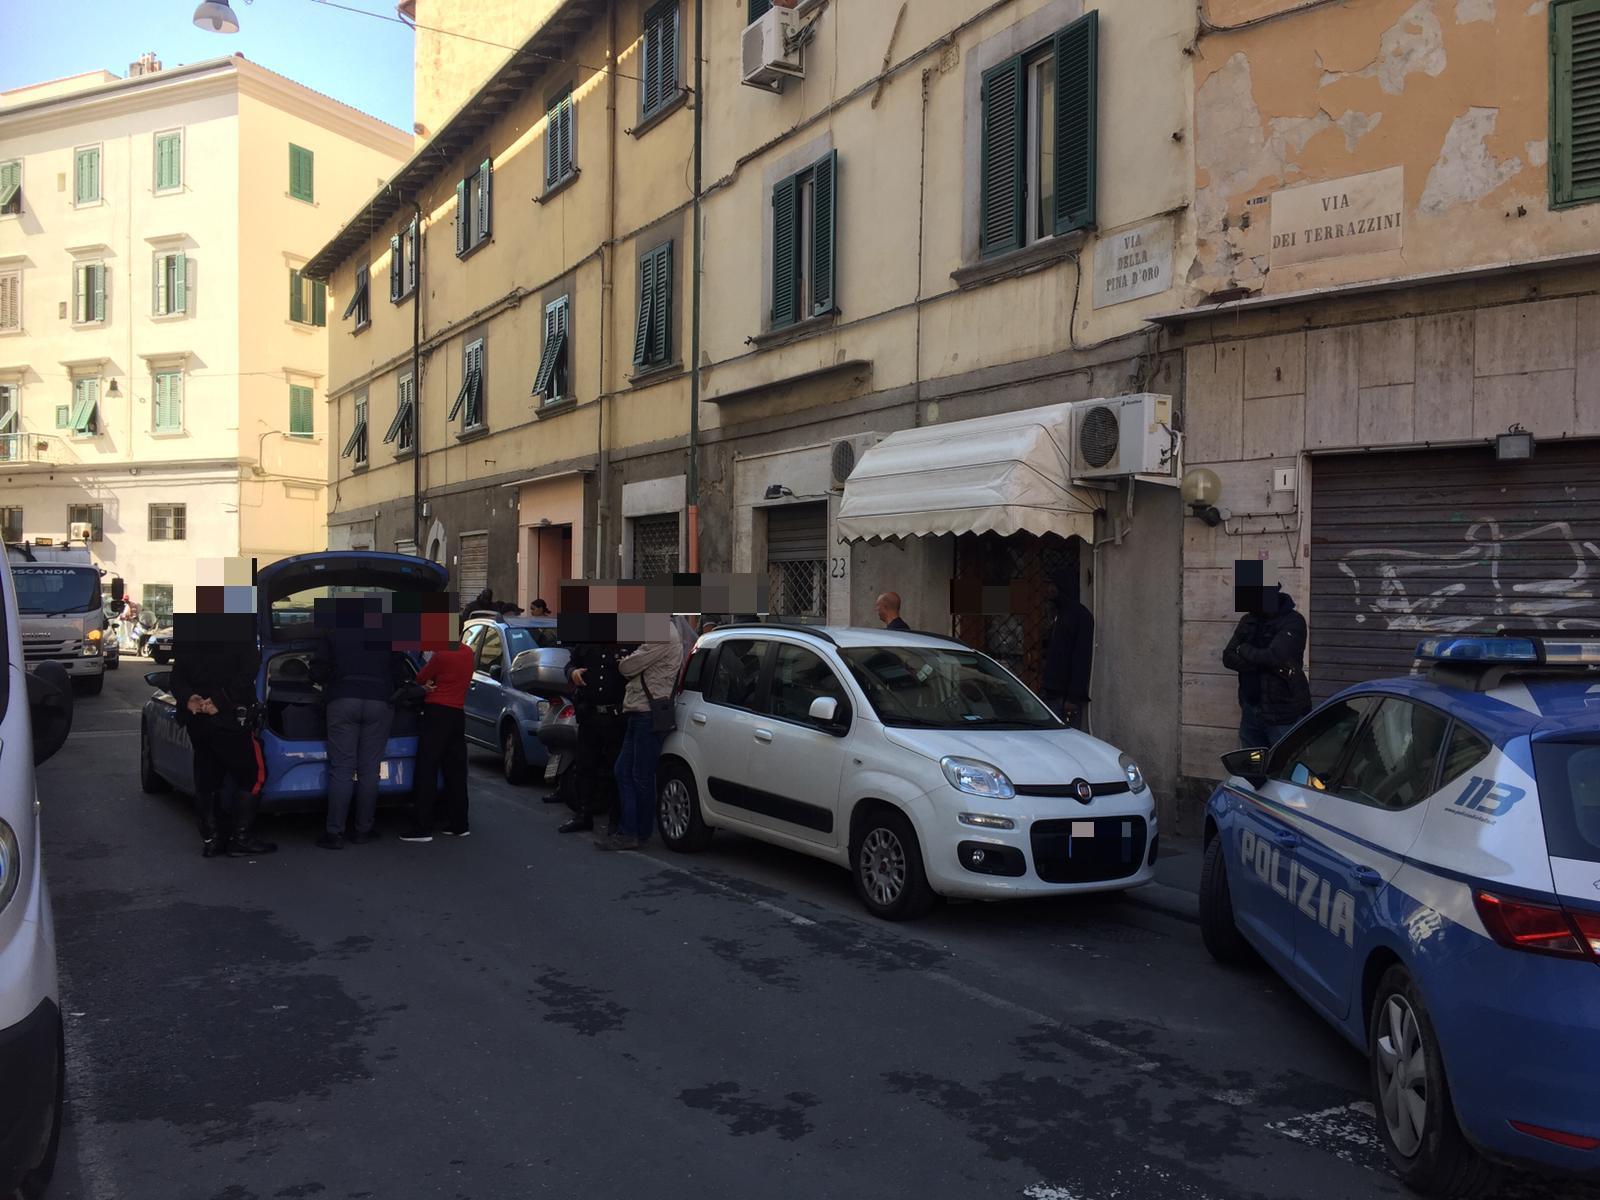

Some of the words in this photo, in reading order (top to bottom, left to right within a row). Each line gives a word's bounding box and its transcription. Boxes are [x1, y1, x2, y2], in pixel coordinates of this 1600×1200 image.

[1322, 194, 1350, 212] VIA
[1123, 234, 1143, 250] VIA
[1272, 232, 1297, 250] DEI
[1304, 212, 1401, 244] TERRAZZINI
[1117, 249, 1148, 271] DELLA
[1106, 274, 1129, 292] PINA
[1131, 265, 1160, 285] D'ORO
[831, 557, 846, 579] 23
[1454, 775, 1527, 817] 113
[1241, 829, 1356, 950] POLIZIA
